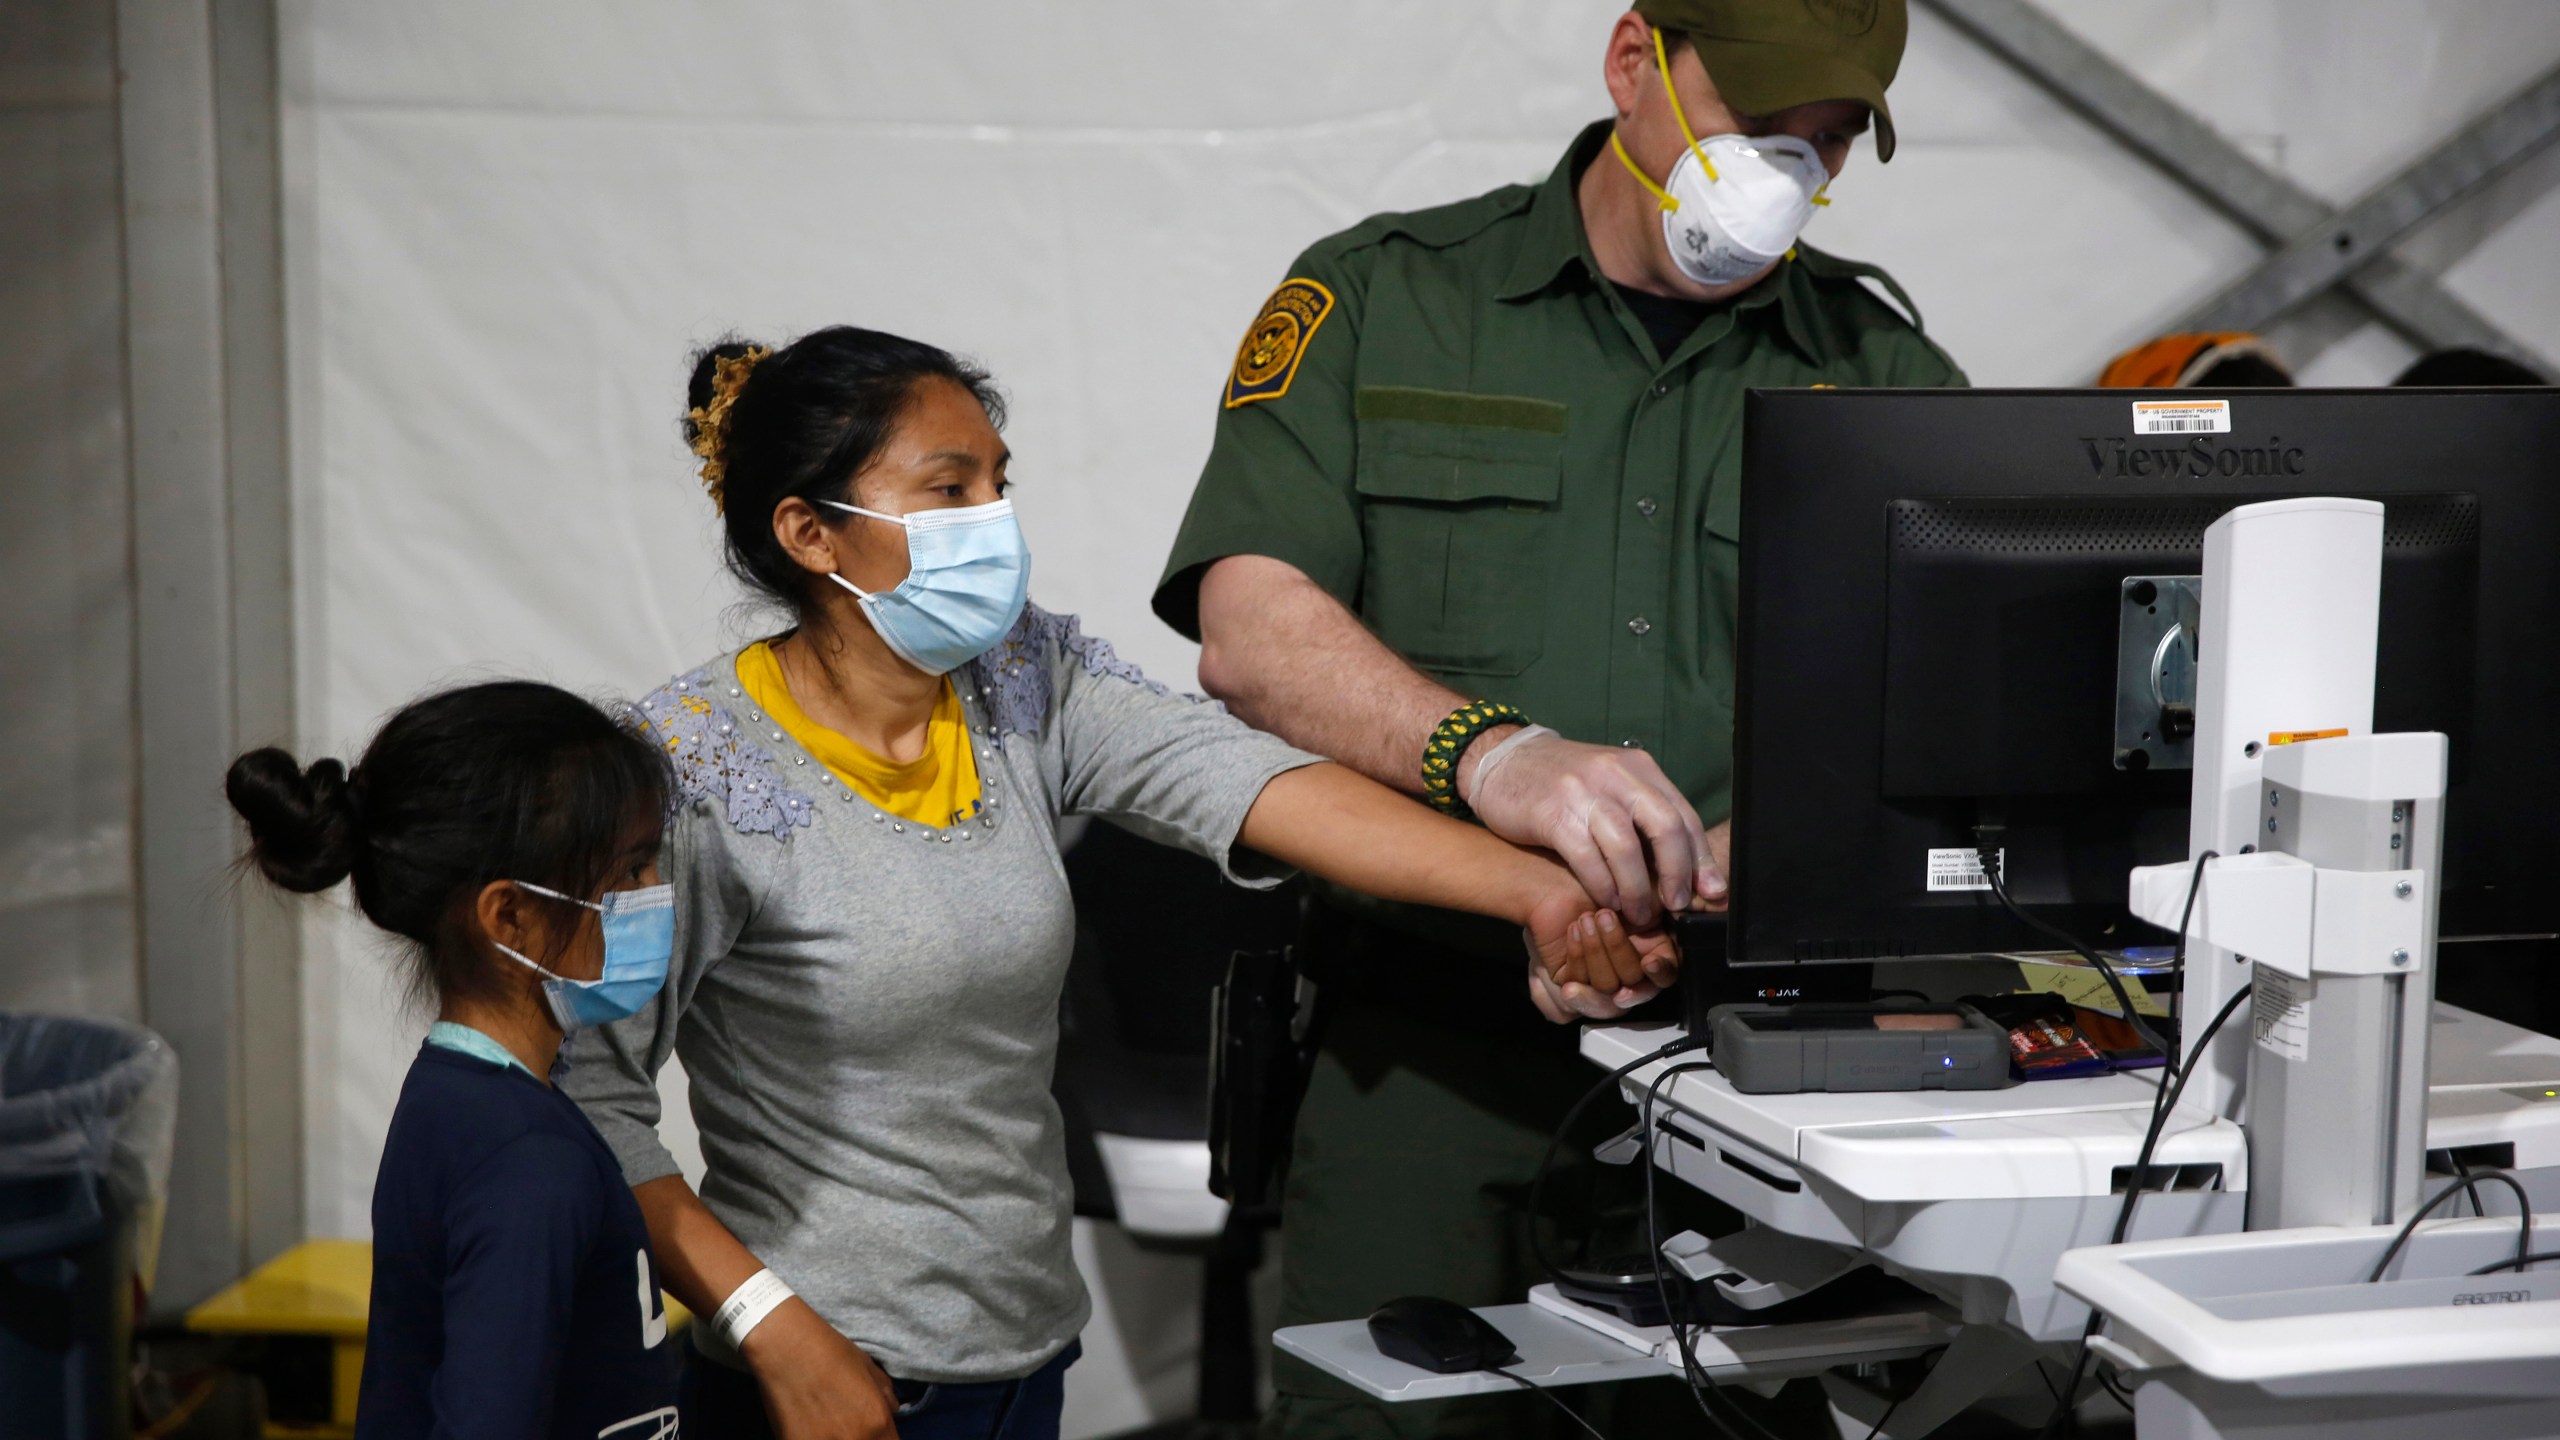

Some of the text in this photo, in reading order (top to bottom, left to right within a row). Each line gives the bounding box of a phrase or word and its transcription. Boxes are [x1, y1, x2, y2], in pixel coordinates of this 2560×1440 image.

[2079, 436, 2305, 478] ViewSonic
[1758, 988, 1800, 998] KOJAK
[2452, 1289, 2531, 1306] ERGOTRON
